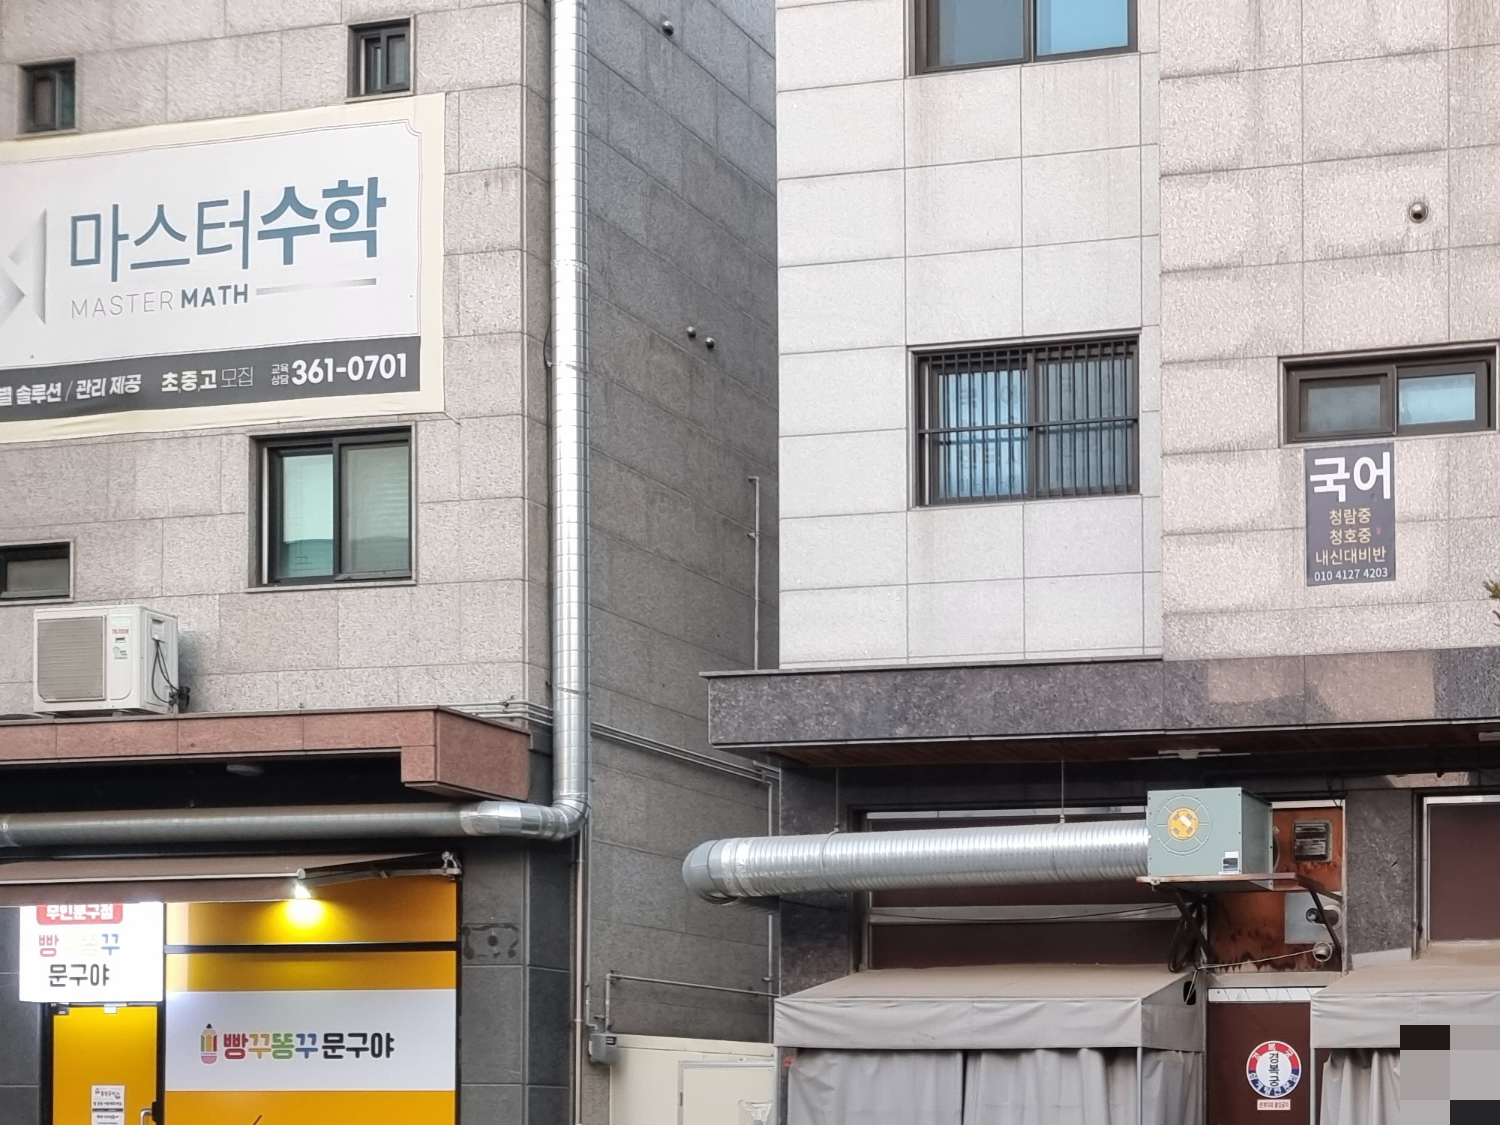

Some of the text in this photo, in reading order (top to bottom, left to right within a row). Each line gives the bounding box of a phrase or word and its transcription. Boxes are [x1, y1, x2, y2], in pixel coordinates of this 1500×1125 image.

[70, 177, 386, 282] 마스터수학
[71, 284, 248, 319] MASTER MATH
[221, 366, 253, 388] 모집
[291, 353, 407, 386] 361-0701
[16, 383, 62, 405] 솔루션
[76, 378, 107, 399] 관리
[109, 374, 141, 394] 제공
[1310, 452, 1391, 502] 국어
[1329, 507, 1371, 525] 청람중
[1329, 527, 1371, 545] 청호중
[1315, 546, 1386, 566] 내신대비반
[1314, 567, 1388, 581] 010 4127 4203
[49, 964, 110, 987] 문구야
[1268, 1053, 1280, 1087] 경복궁
